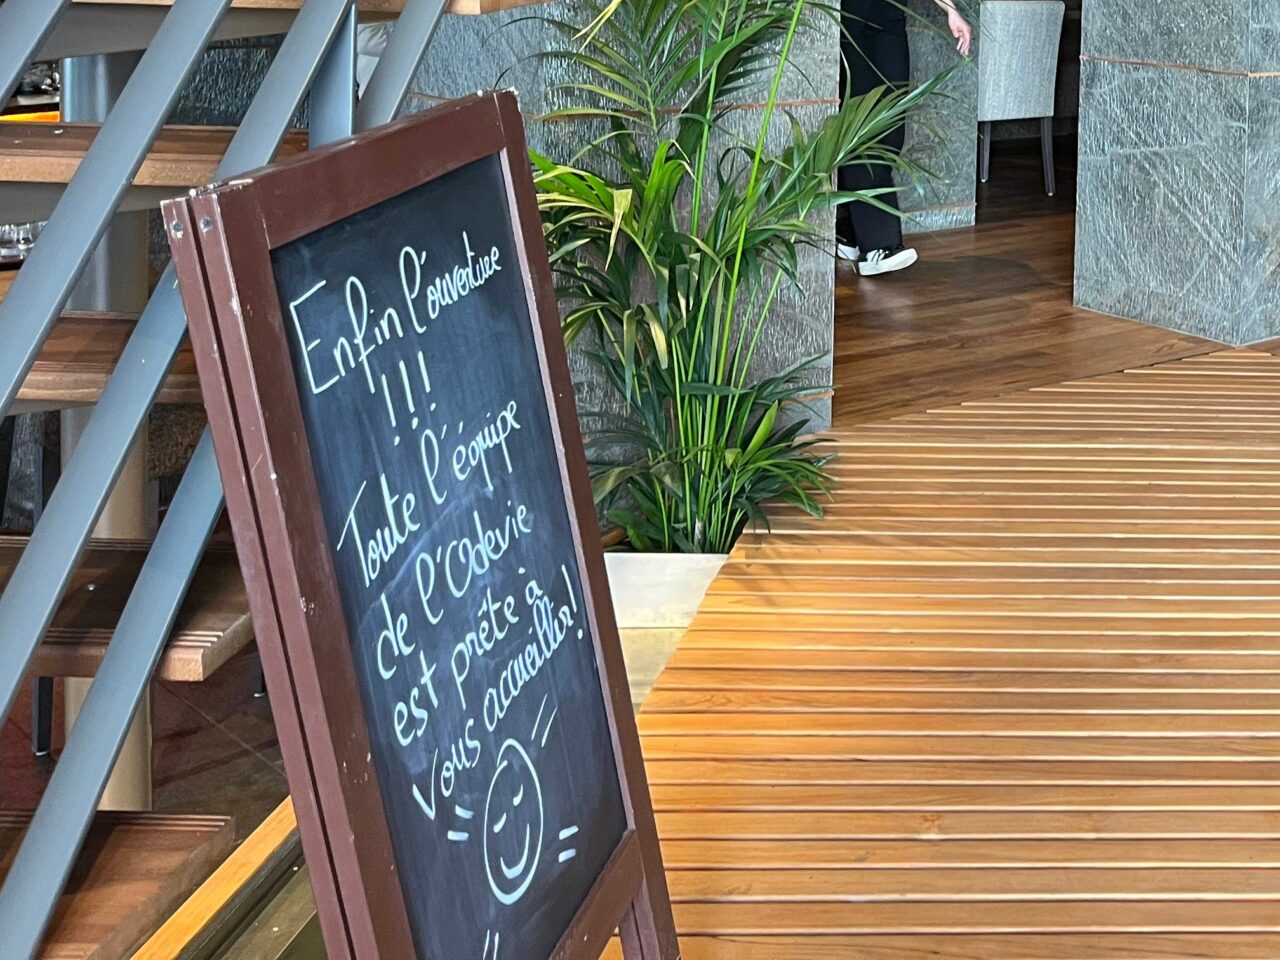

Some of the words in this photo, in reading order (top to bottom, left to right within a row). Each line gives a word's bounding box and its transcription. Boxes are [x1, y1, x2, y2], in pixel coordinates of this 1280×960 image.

[290, 276, 404, 394] Enfin
[337, 473, 421, 588] Toute
[420, 400, 521, 505] l'équipe
[377, 592, 416, 680] de
[394, 649, 439, 747] est
[451, 587, 520, 711] prête
[518, 566, 543, 606] à
